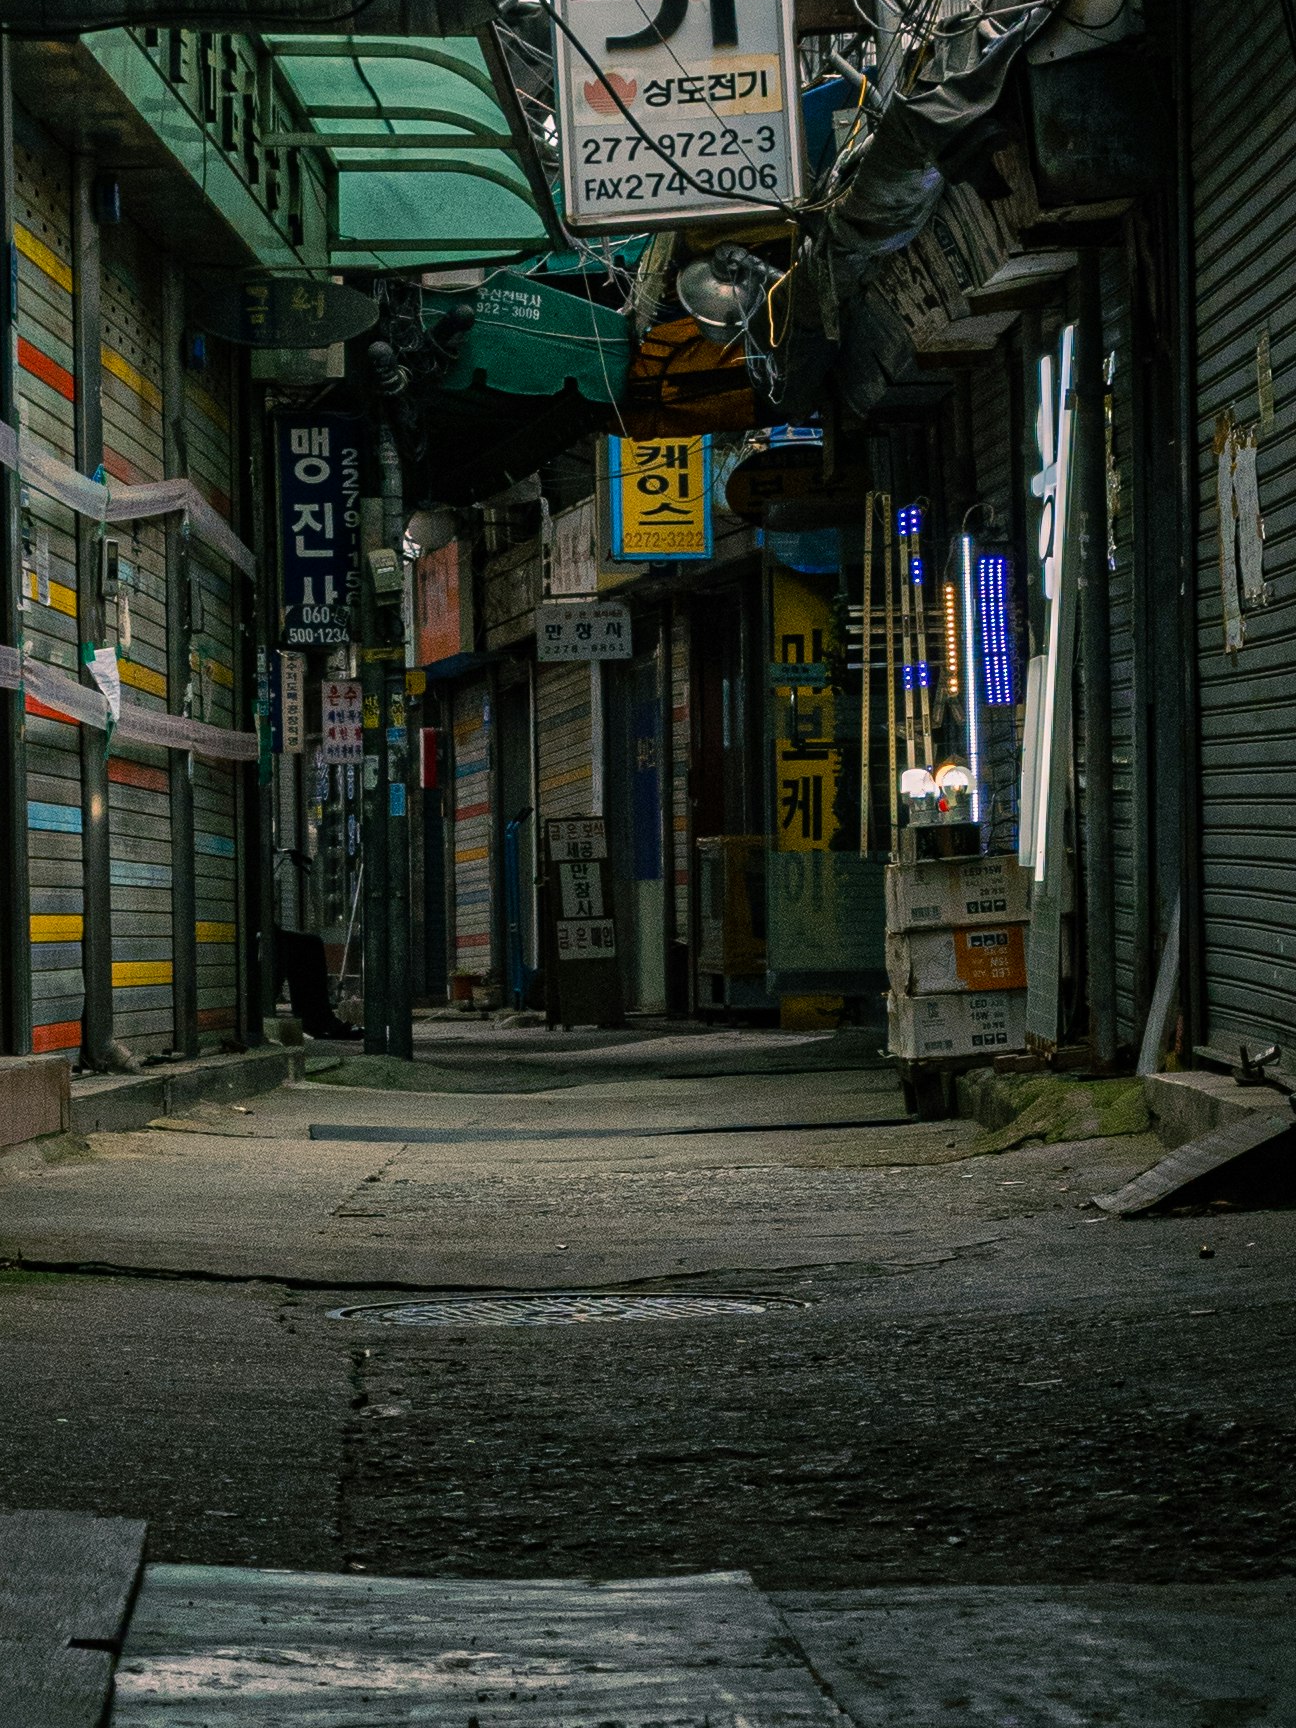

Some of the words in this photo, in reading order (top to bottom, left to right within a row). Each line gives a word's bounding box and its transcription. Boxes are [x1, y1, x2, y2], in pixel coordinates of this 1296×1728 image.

[643, 69, 768, 108] 상도전기
[582, 125, 775, 165] 277-9722-3
[636, 444, 695, 526] 케이스
